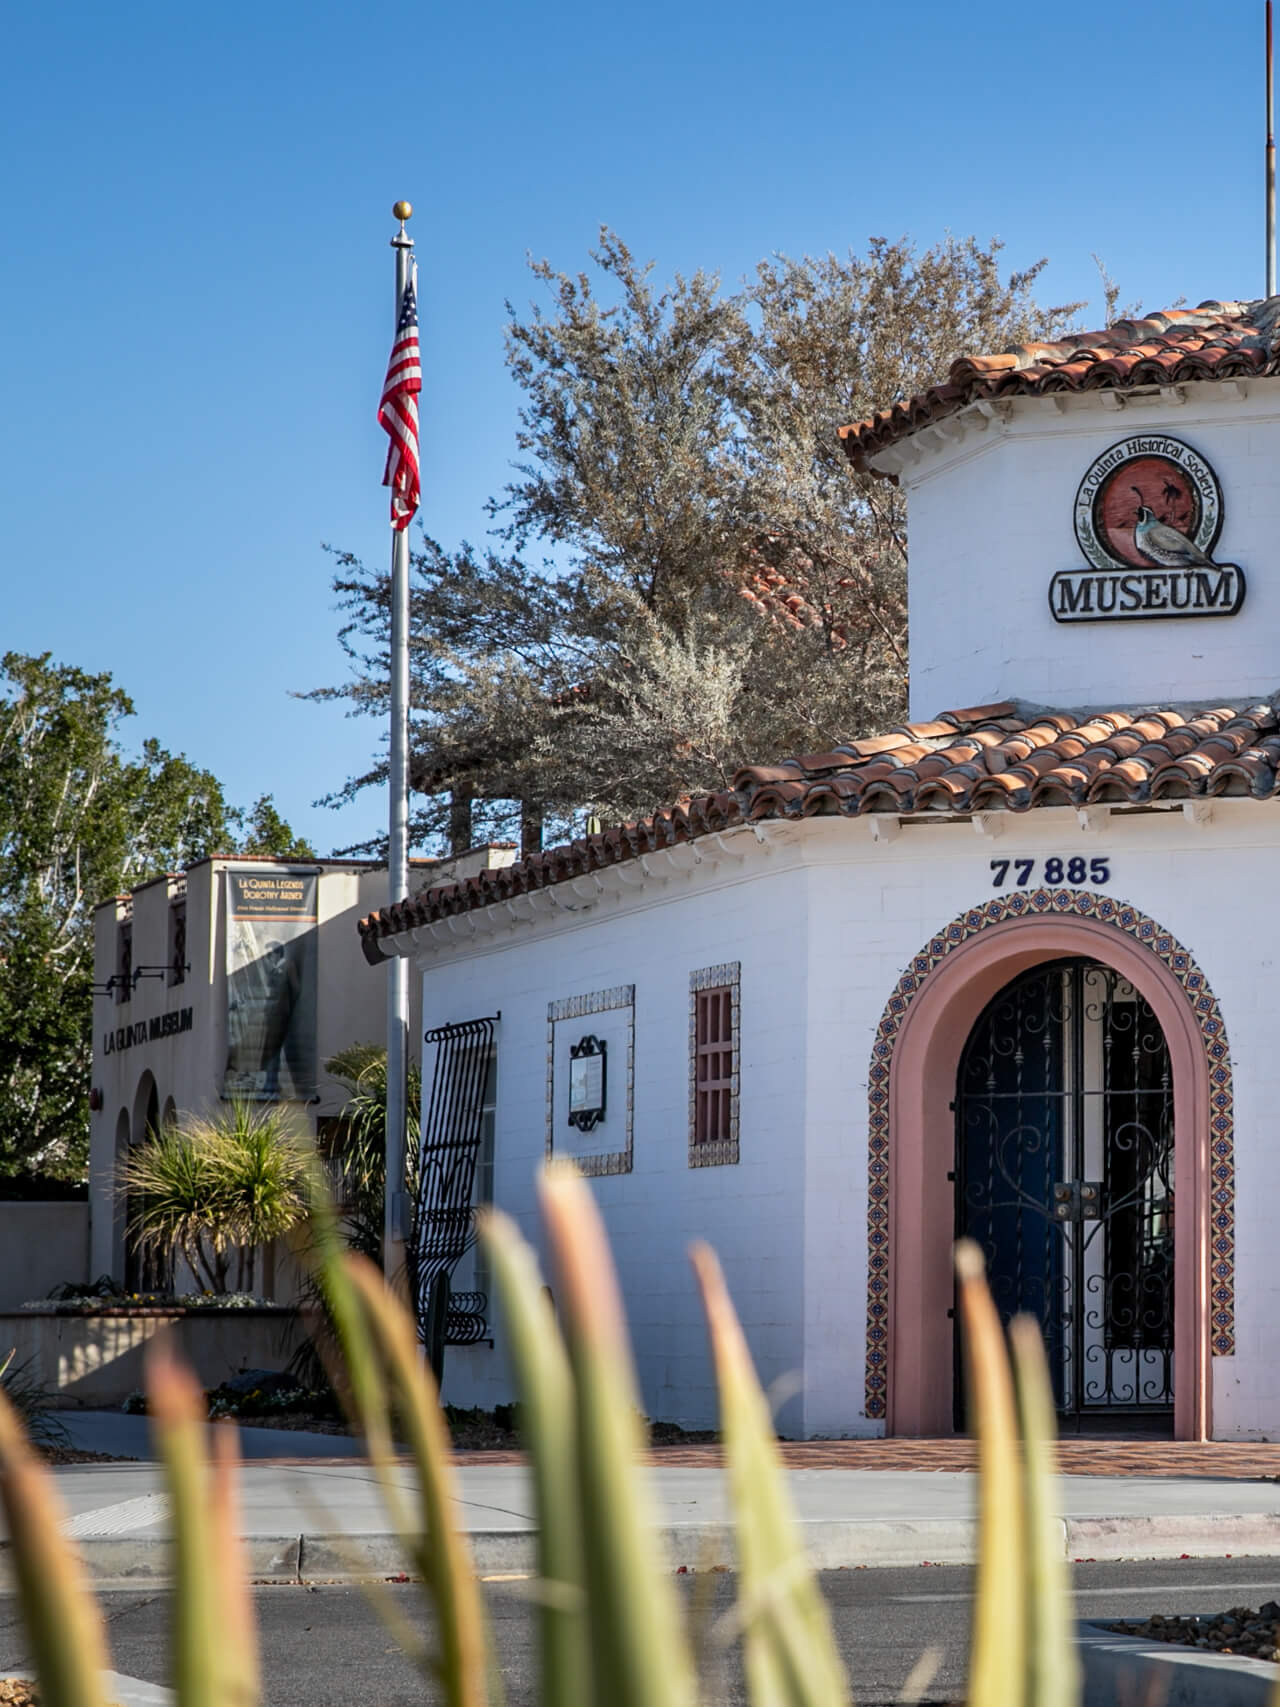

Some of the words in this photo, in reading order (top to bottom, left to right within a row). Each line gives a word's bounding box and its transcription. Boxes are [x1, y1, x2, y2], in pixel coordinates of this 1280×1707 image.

[1079, 487, 1095, 508] La
[1087, 448, 1125, 486] Quinta
[1126, 439, 1184, 459] Historical
[1183, 454, 1216, 506] Society
[1057, 572, 1234, 614] MUSEUM
[104, 1031, 115, 1056] LA
[116, 1020, 148, 1051] QUINTA
[149, 1006, 193, 1041] MUSEUM
